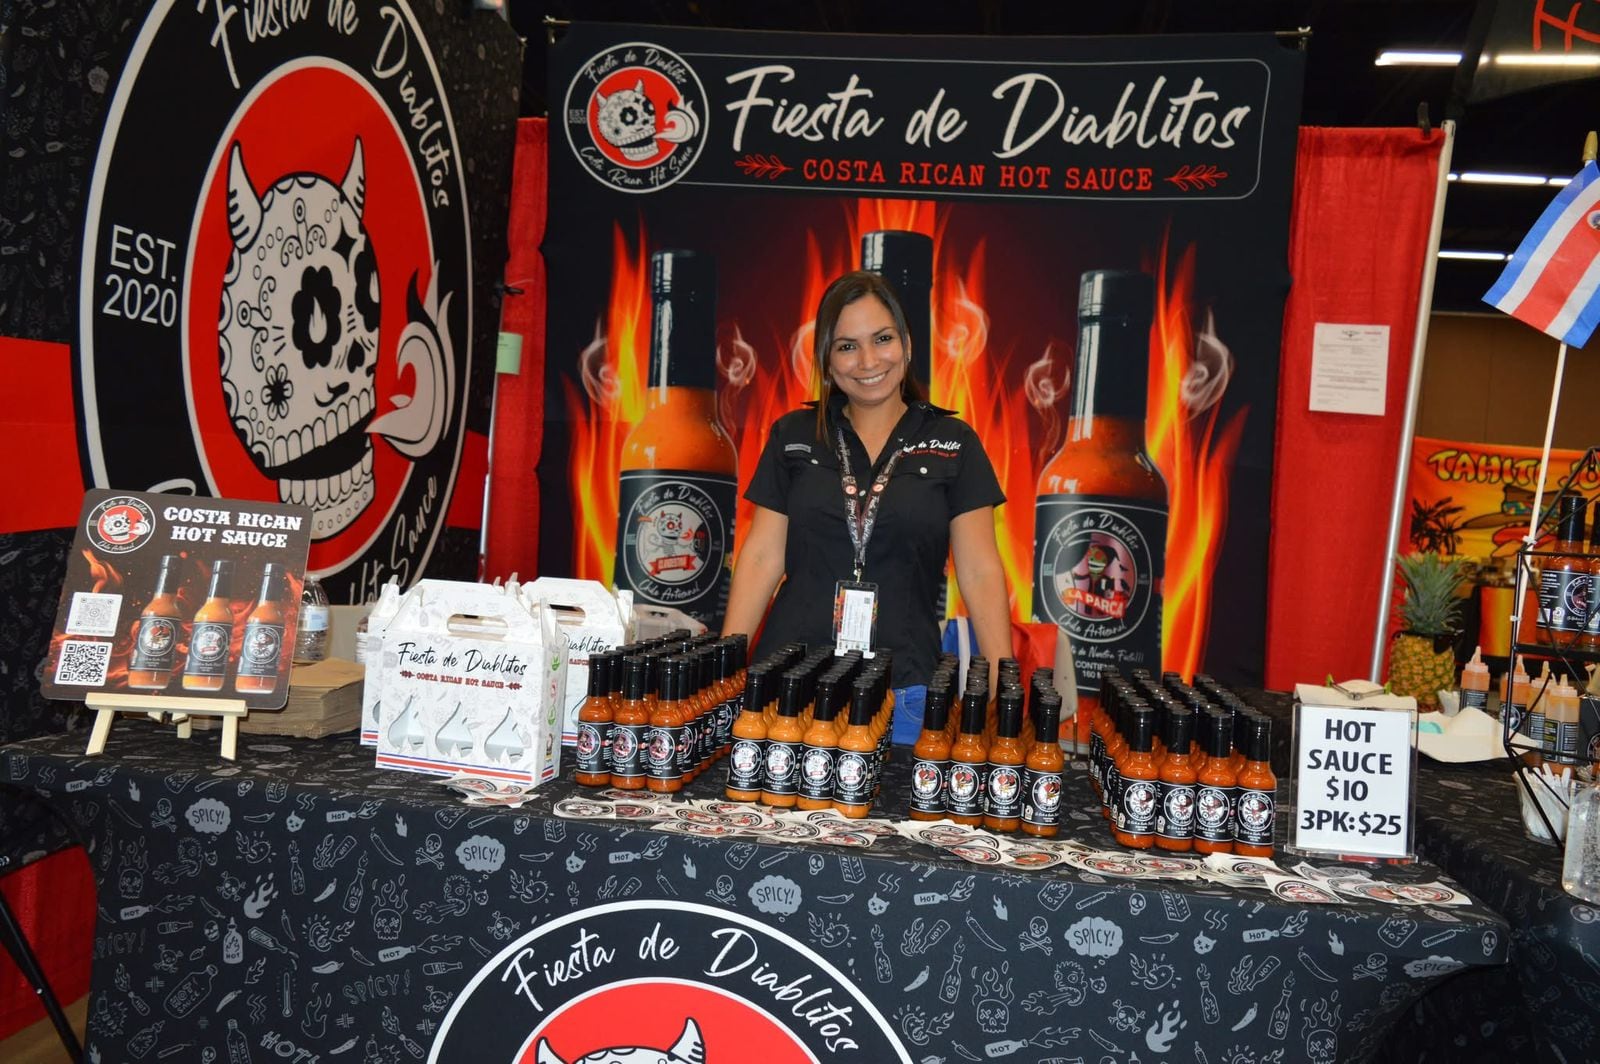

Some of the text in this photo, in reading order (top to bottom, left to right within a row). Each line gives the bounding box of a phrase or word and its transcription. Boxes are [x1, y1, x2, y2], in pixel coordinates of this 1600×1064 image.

[372, 6, 450, 208] Diablitos
[725, 64, 1251, 160] Fiesta de Diablitos
[803, 161, 1153, 191] COSTA RICAN HOT SAUCE
[111, 224, 177, 282] EST.
[102, 275, 177, 327] 2020
[163, 506, 302, 532] COSTA RICAN
[171, 525, 288, 549] HOT SAUCE
[391, 475, 438, 588] Sauce
[1085, 594, 1124, 617] PARCA
[398, 641, 528, 676] Fiesta de Diablitos
[416, 672, 438, 682] COSTA
[465, 677, 479, 687] HOT
[1325, 718, 1376, 743] HOT
[1307, 749, 1393, 775] SAUCE
[1326, 775, 1369, 801] $10
[192, 808, 225, 825] SPICY!
[330, 812, 346, 820] HOT
[1300, 809, 1402, 836] 3PK:$25
[463, 845, 499, 864] SPICY!
[614, 853, 630, 862] HOT
[756, 886, 795, 905] SPICY!
[919, 895, 936, 903] HOT
[1072, 928, 1116, 947] SPICY!
[1249, 931, 1266, 940] HOT
[382, 950, 400, 960] HOT
[501, 922, 859, 1053] Fiesta de Diablitos
[990, 1044, 1011, 1054] HOT
